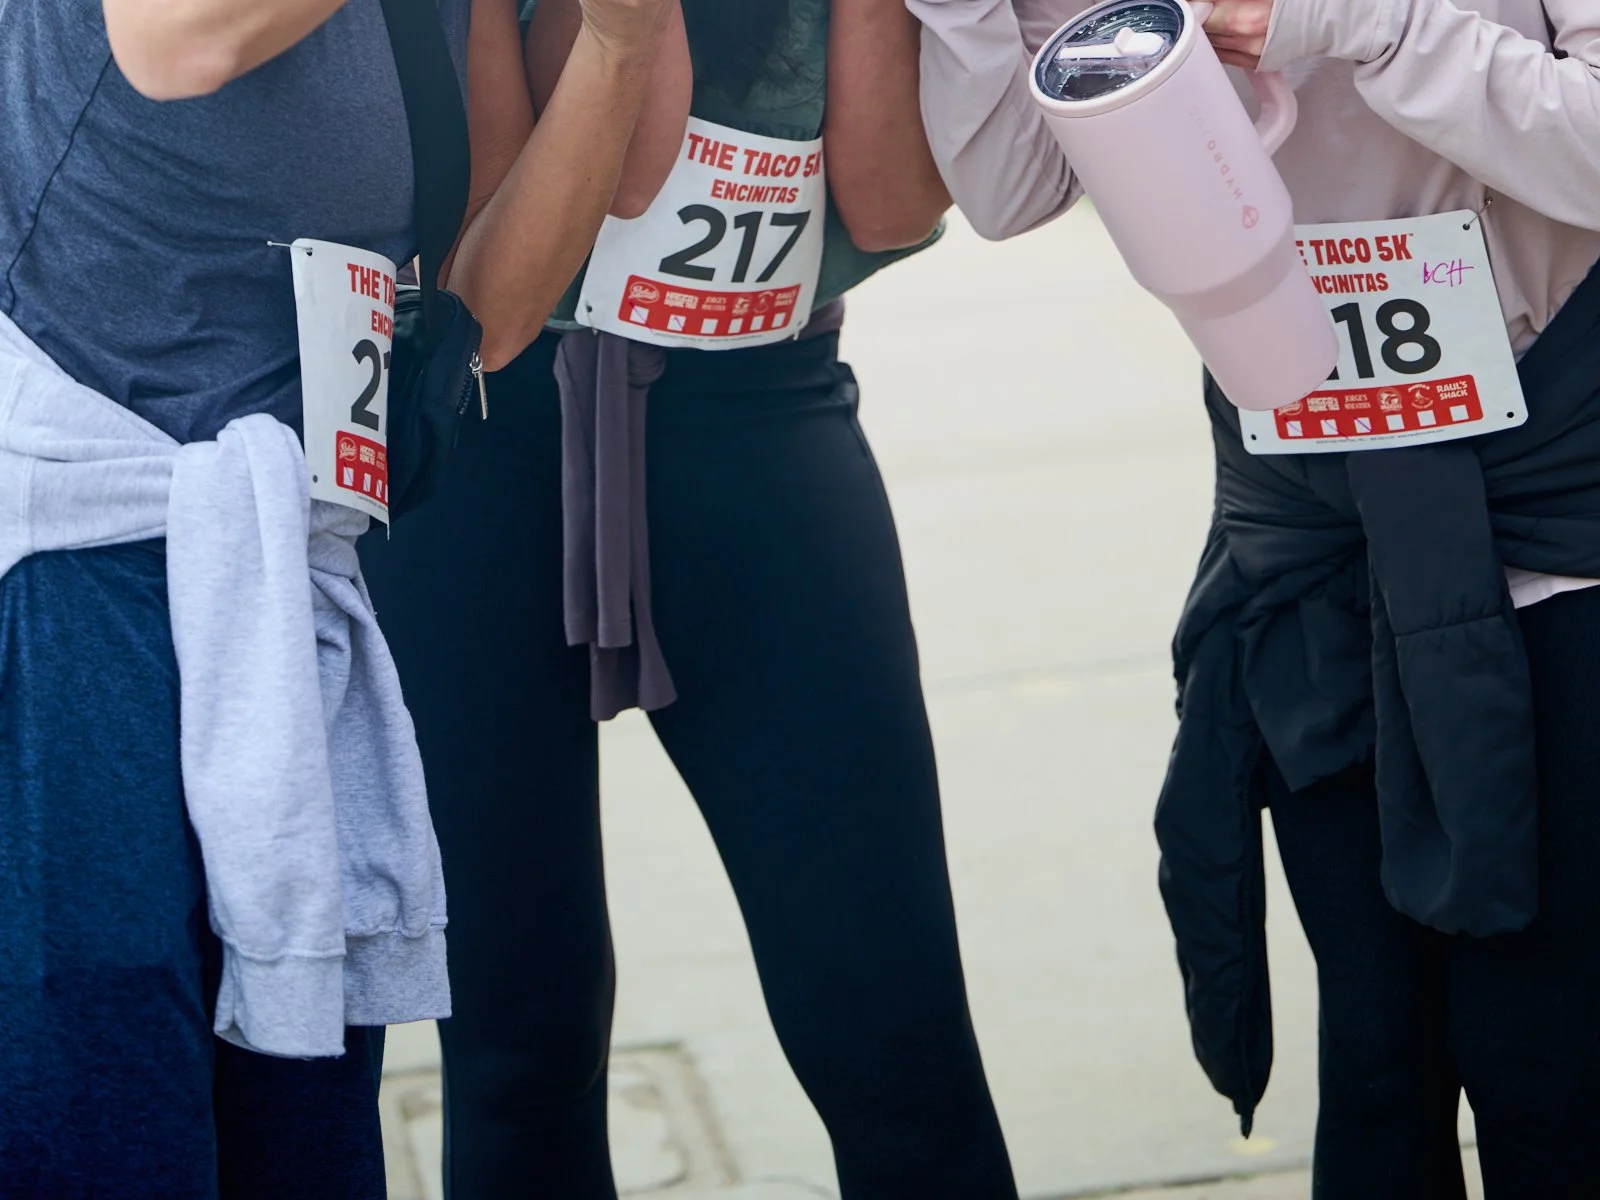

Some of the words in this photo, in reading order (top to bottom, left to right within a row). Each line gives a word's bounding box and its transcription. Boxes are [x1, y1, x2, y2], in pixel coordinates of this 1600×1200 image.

[687, 133, 738, 171] THE
[743, 148, 801, 178] TACO
[710, 178, 799, 204] ENCINITAS
[658, 203, 811, 283] 217
[1309, 238, 1371, 265] TACO
[1374, 234, 1413, 261] 5K
[347, 263, 380, 300] THE
[383, 274, 396, 308] TA
[1327, 298, 1442, 380] 18
[351, 339, 391, 436] 2
[1436, 381, 1468, 393] RAUL'S
[1440, 389, 1468, 400] SHACK
